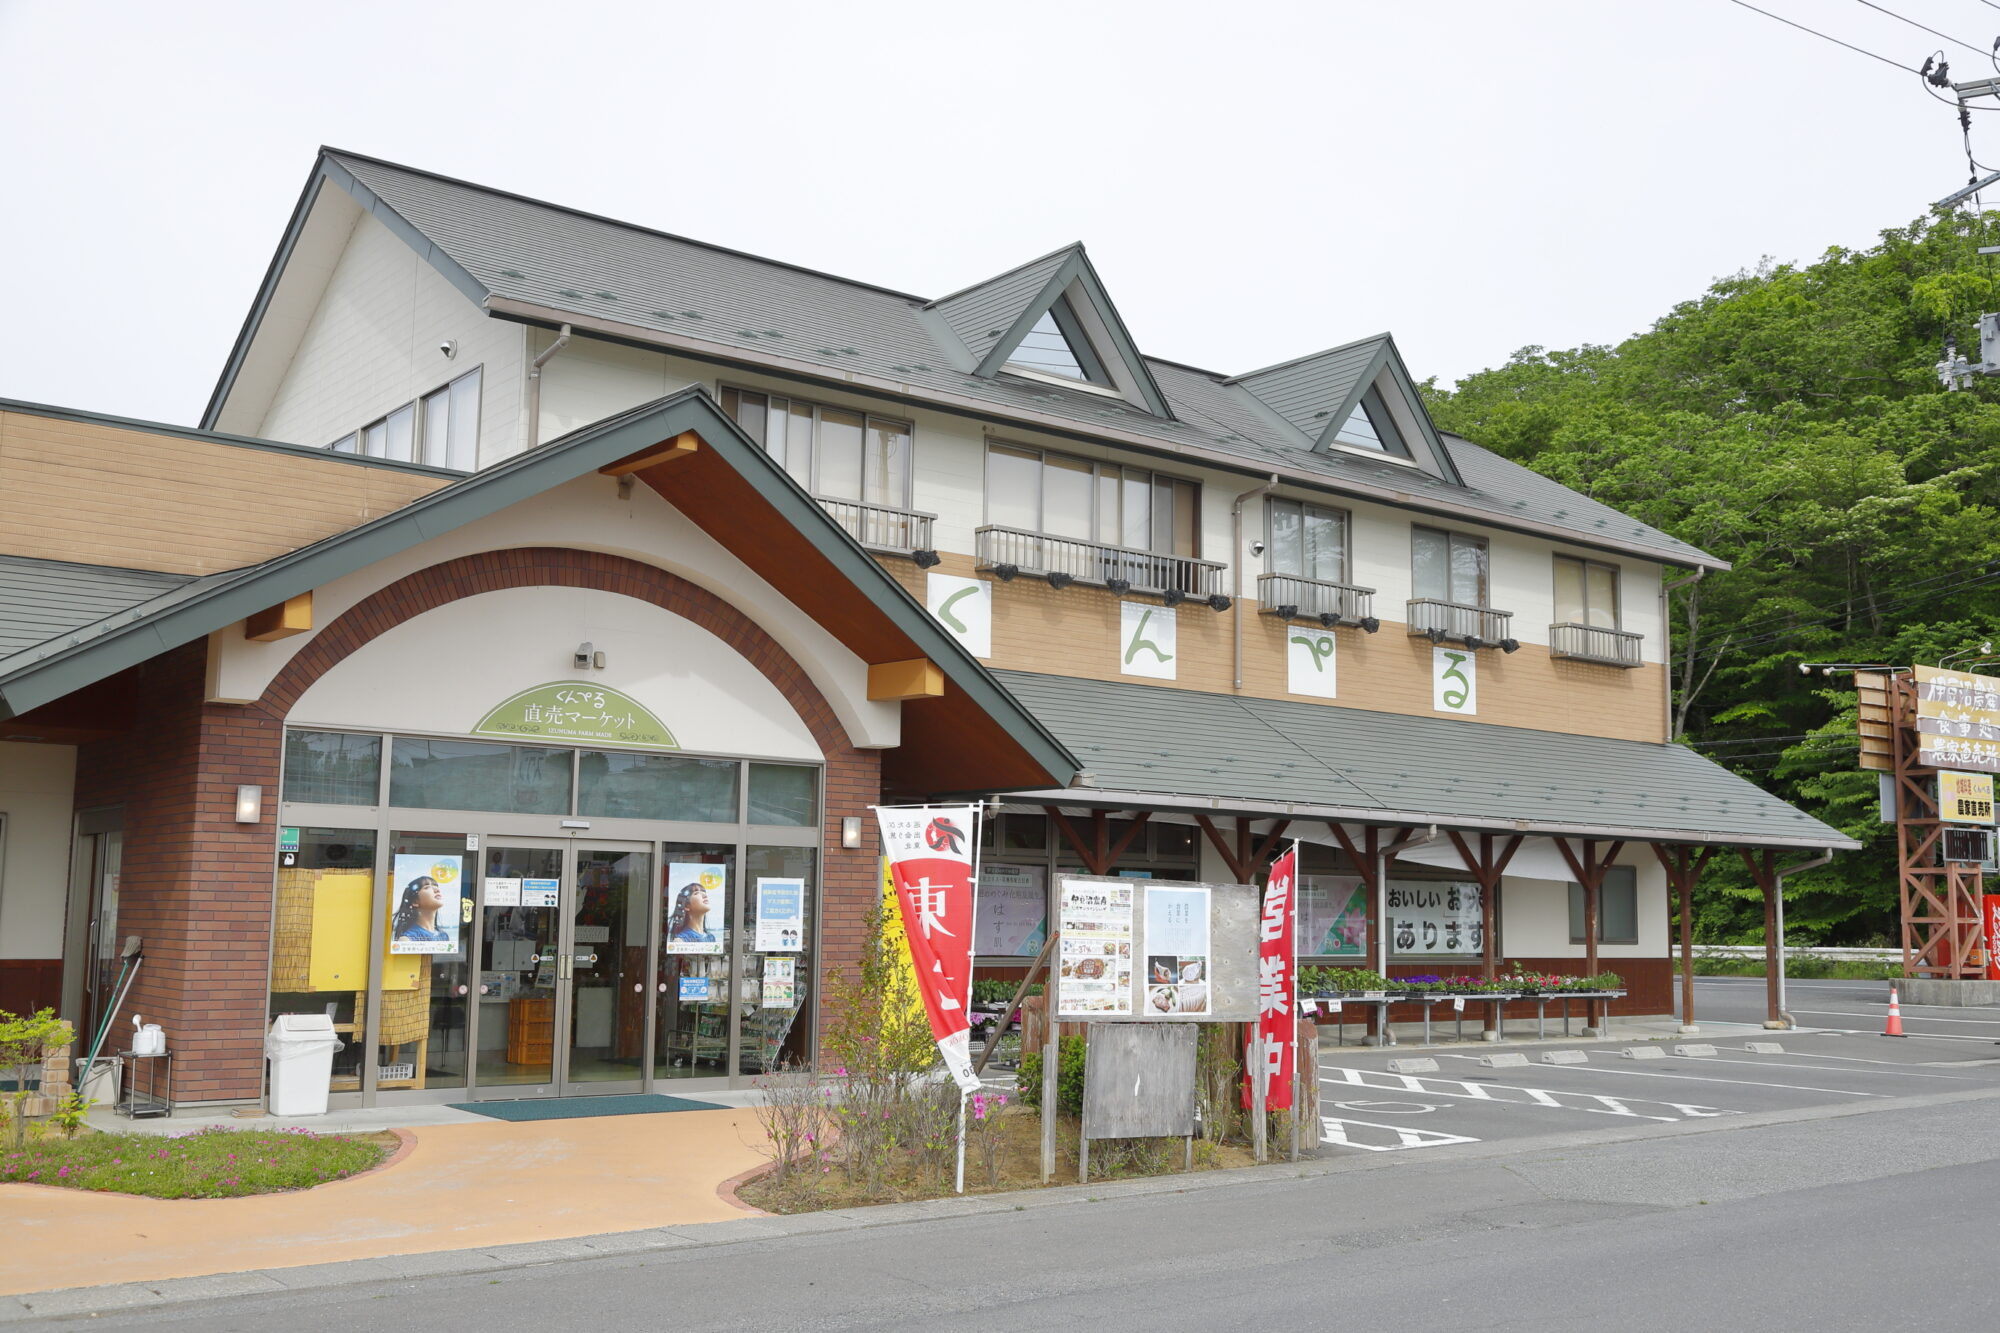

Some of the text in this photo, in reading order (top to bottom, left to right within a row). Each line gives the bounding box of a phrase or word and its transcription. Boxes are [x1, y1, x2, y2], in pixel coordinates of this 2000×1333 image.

[555, 690, 606, 709] くんぺる
[524, 703, 636, 730] 直売マーケット
[1936, 710, 1993, 739] 食事処
[578, 729, 594, 737] FARM
[1932, 737, 1998, 768] 農家直売所
[1388, 889, 1441, 908] おいしい
[1396, 920, 1483, 950] あります
